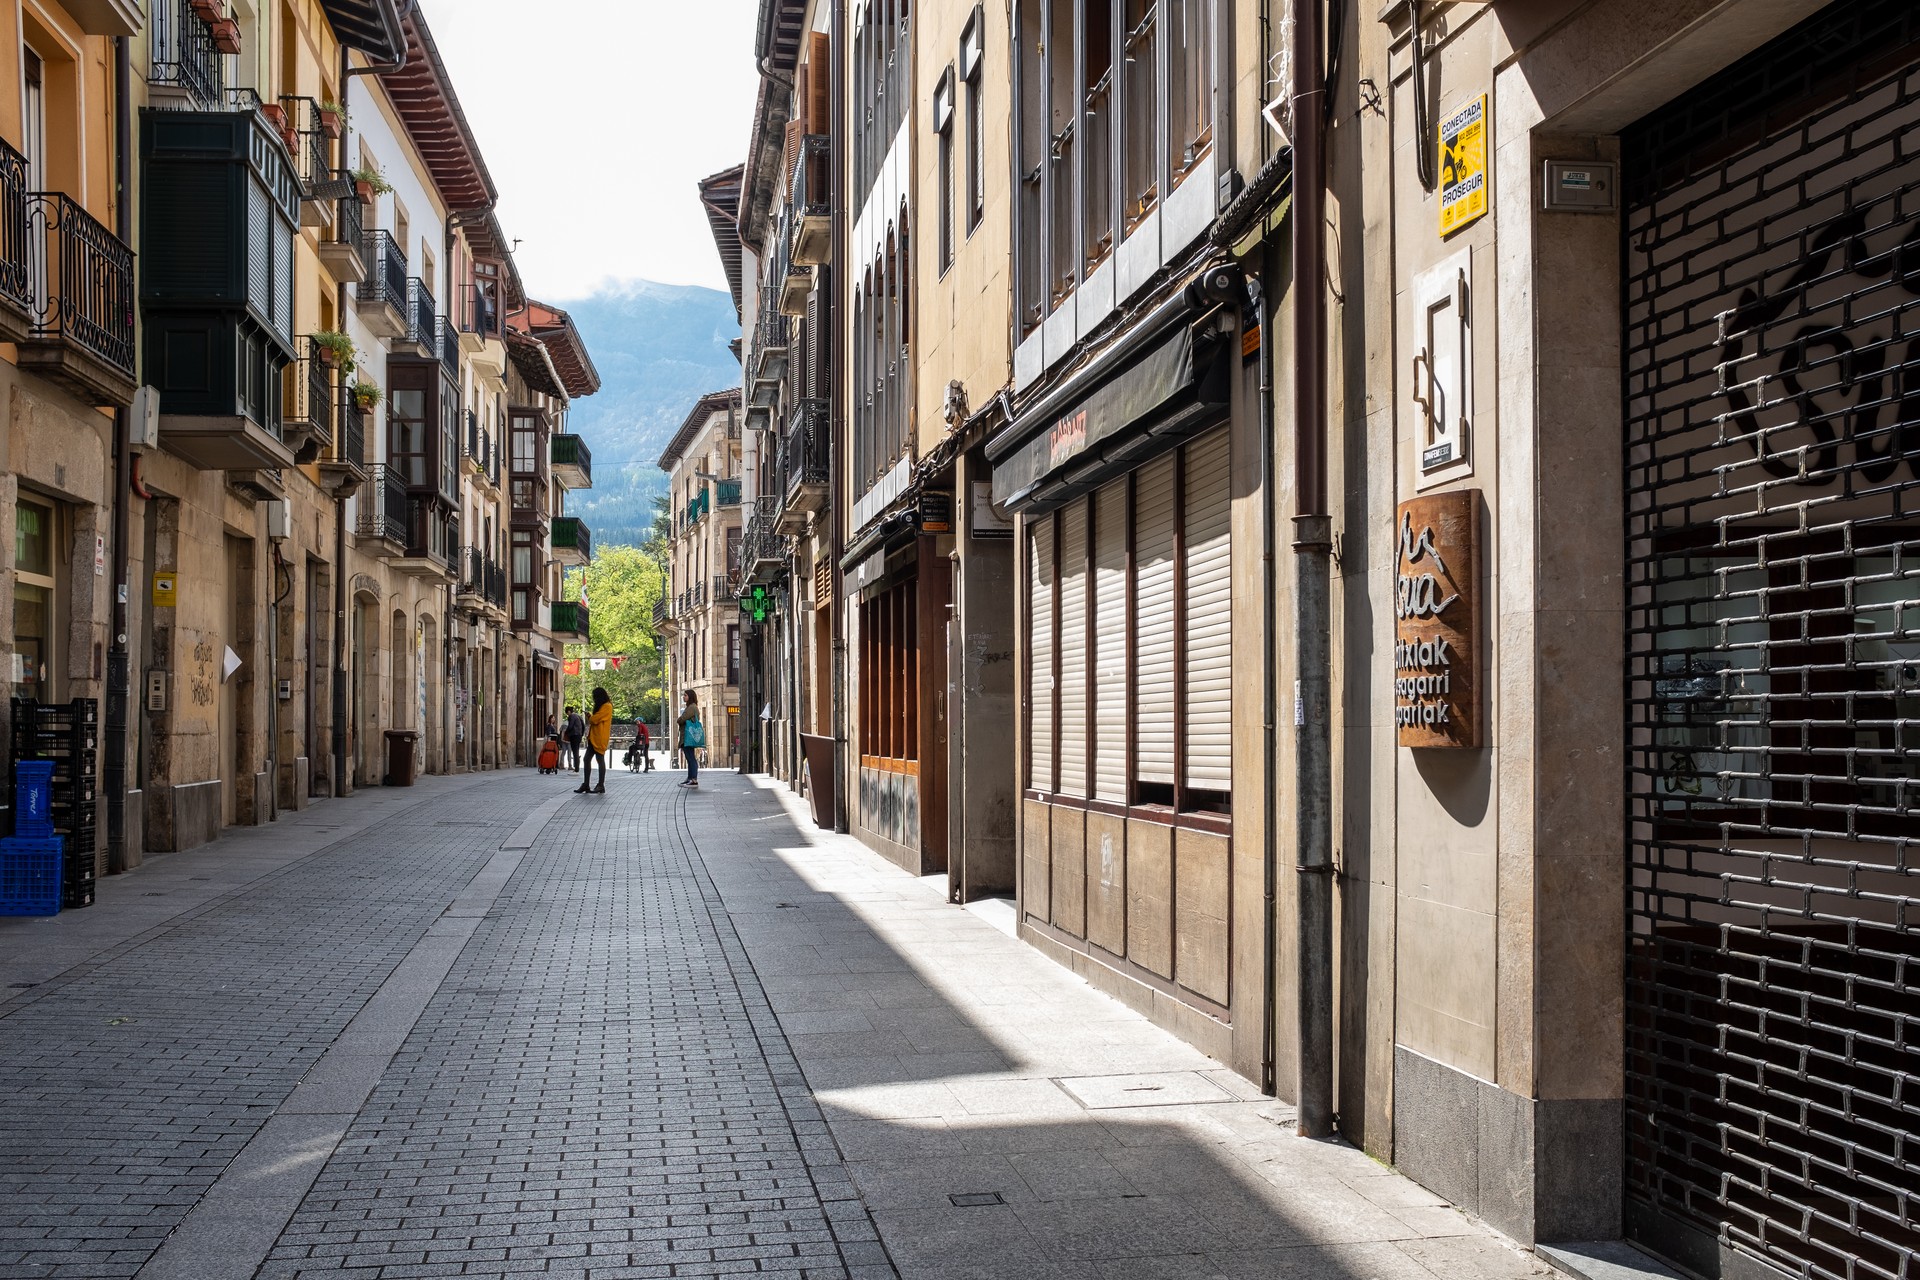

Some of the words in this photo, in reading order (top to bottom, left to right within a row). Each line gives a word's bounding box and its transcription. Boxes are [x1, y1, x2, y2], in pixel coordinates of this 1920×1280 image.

[1441, 102, 1482, 135] CONECTADA
[1442, 173, 1483, 207] PROSEGUR
[1396, 634, 1450, 669] itxiak
[1396, 669, 1450, 701] sagarri
